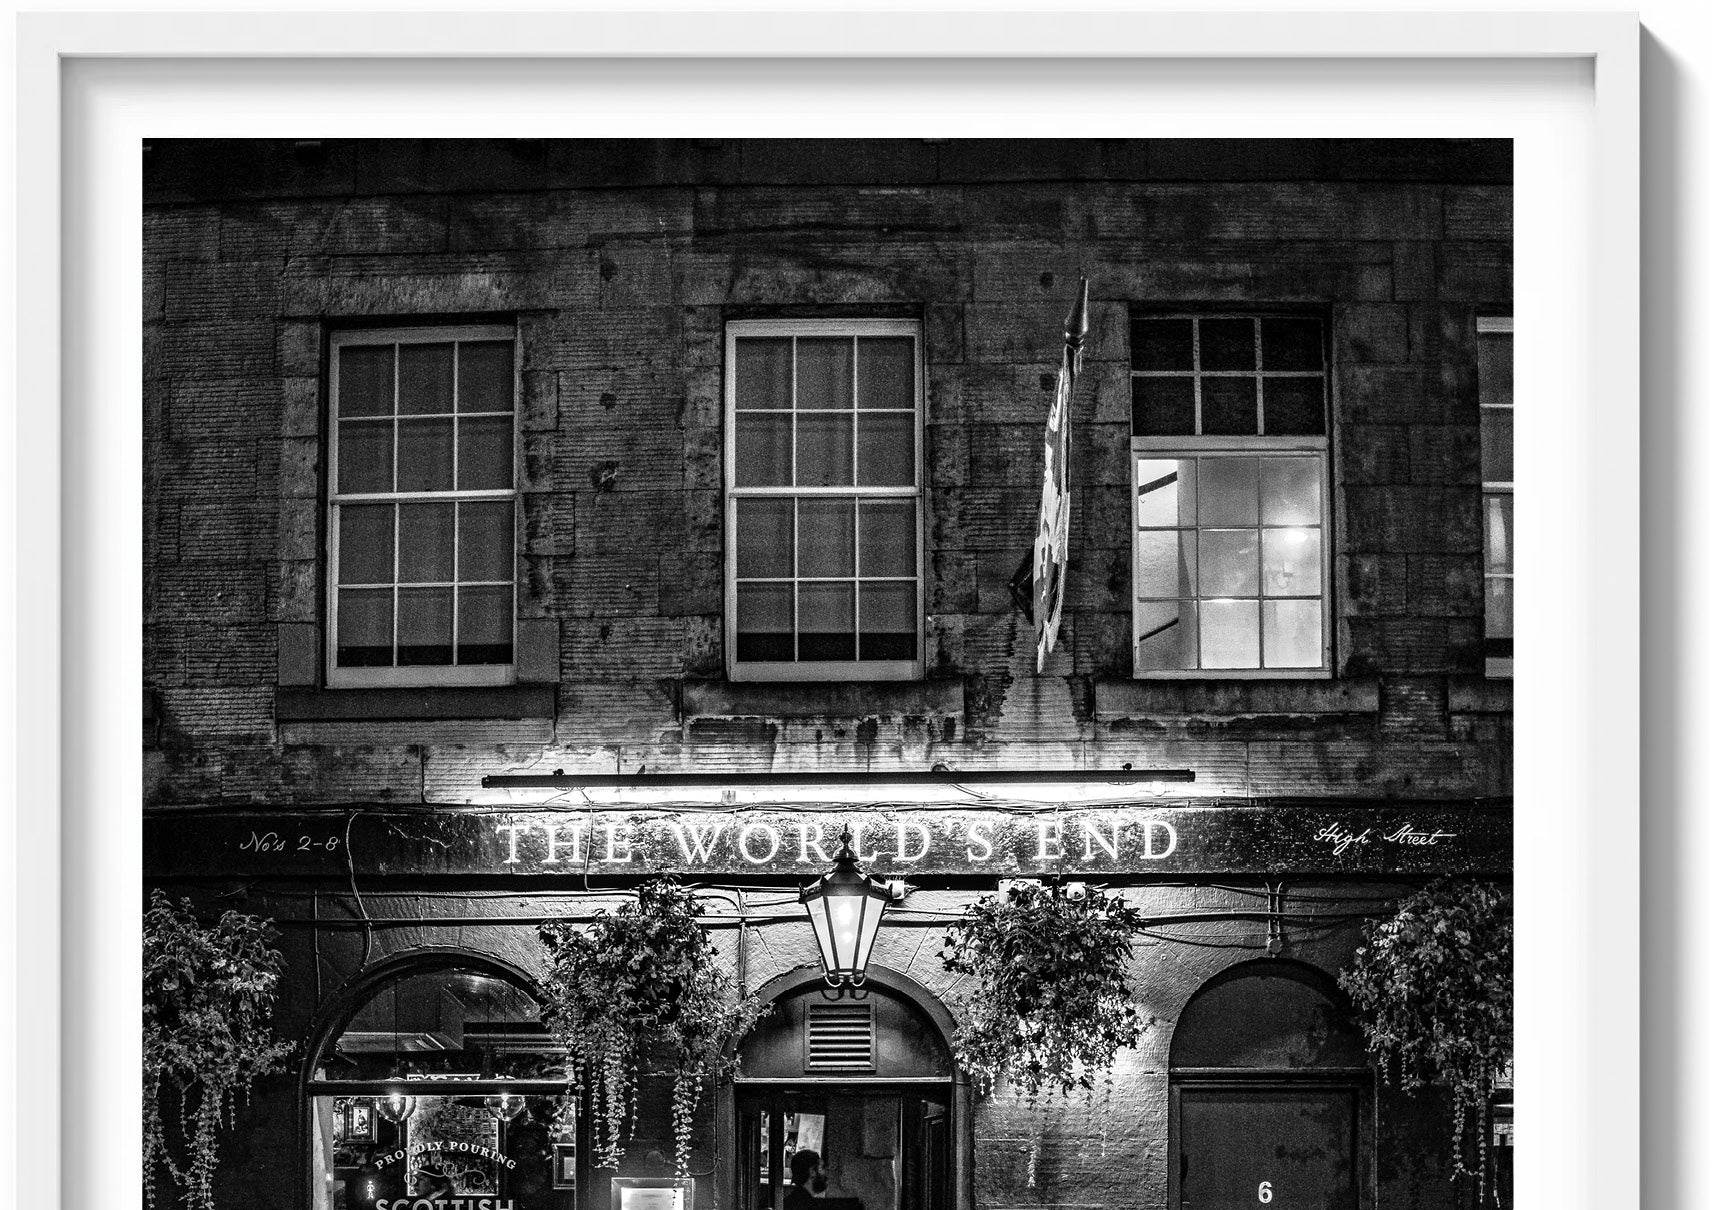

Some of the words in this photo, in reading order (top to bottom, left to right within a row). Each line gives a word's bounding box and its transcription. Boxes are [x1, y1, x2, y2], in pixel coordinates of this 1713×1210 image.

[297, 836, 339, 851] 2-8
[496, 823, 633, 863] THE
[673, 822, 994, 865] WORLD'S
[1033, 821, 1178, 861] END
[1314, 821, 1371, 855] High
[1383, 824, 1457, 845] Street
[449, 1141, 517, 1170] POURING
[1258, 1181, 1273, 1204] 6
